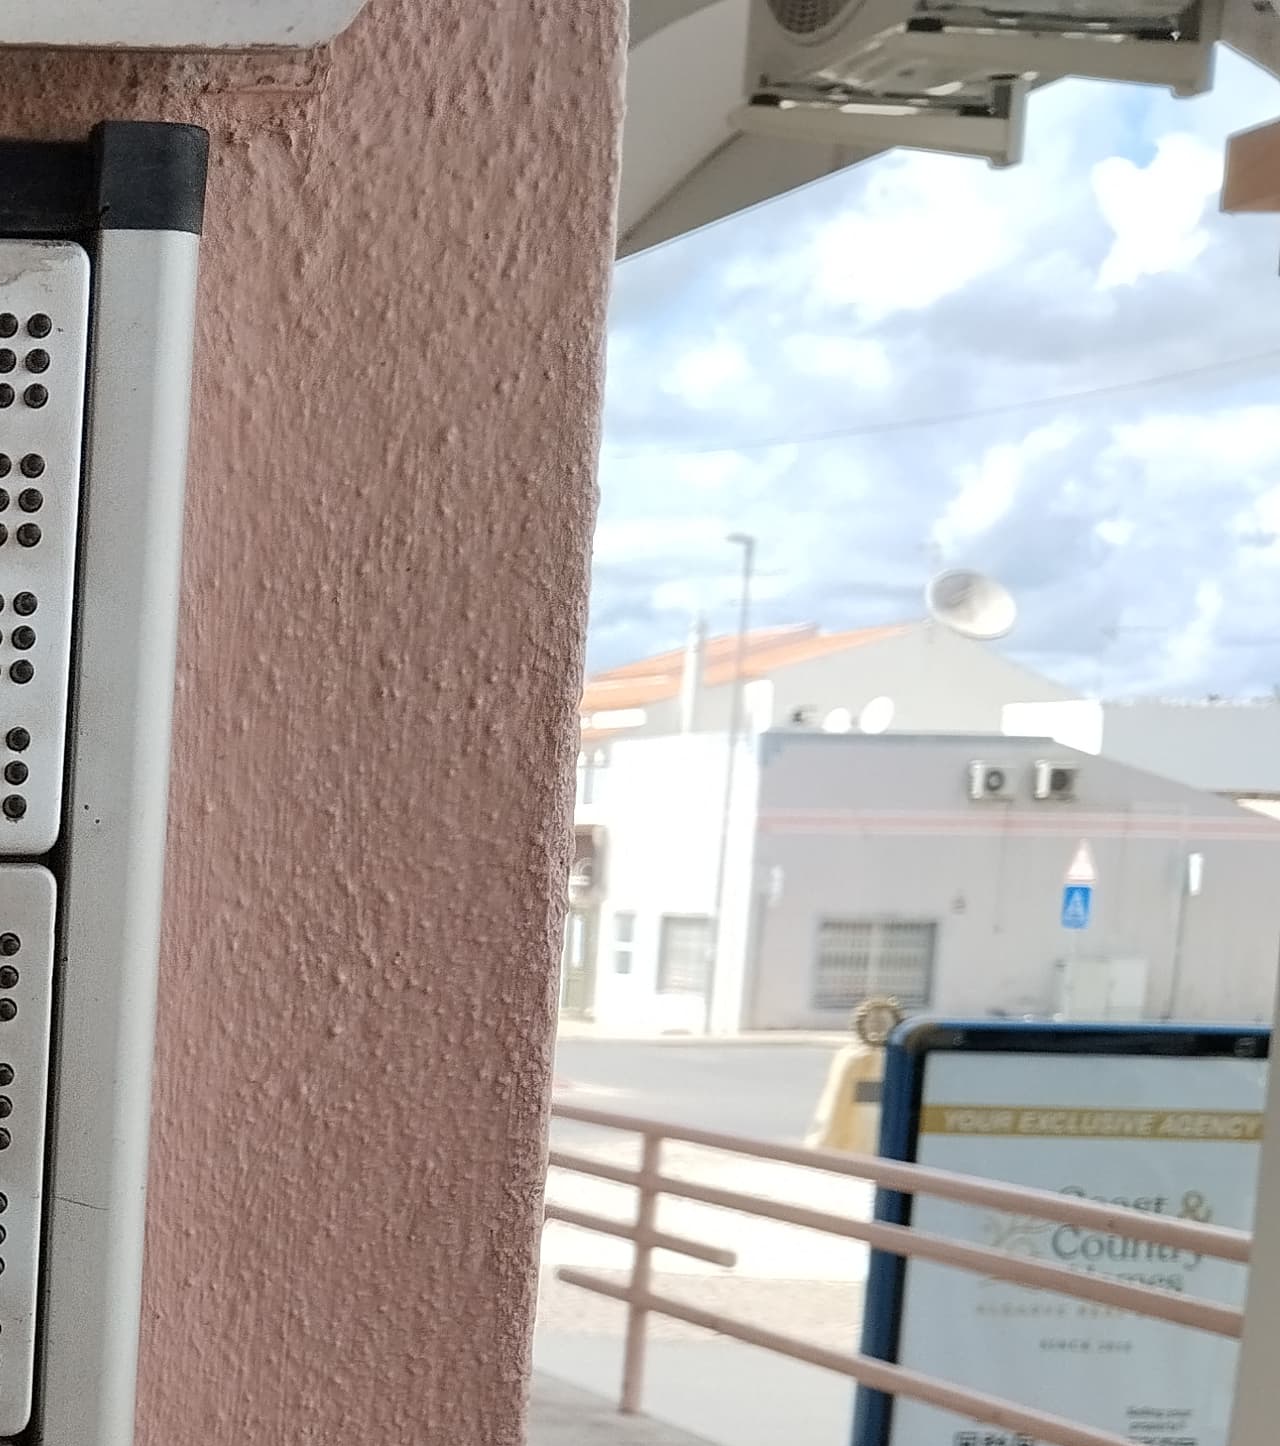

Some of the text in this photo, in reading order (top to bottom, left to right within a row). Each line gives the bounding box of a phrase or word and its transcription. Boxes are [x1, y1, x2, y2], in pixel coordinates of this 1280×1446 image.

[942, 1109, 1263, 1139] YOUR EXCLUSIVE AGENCY
